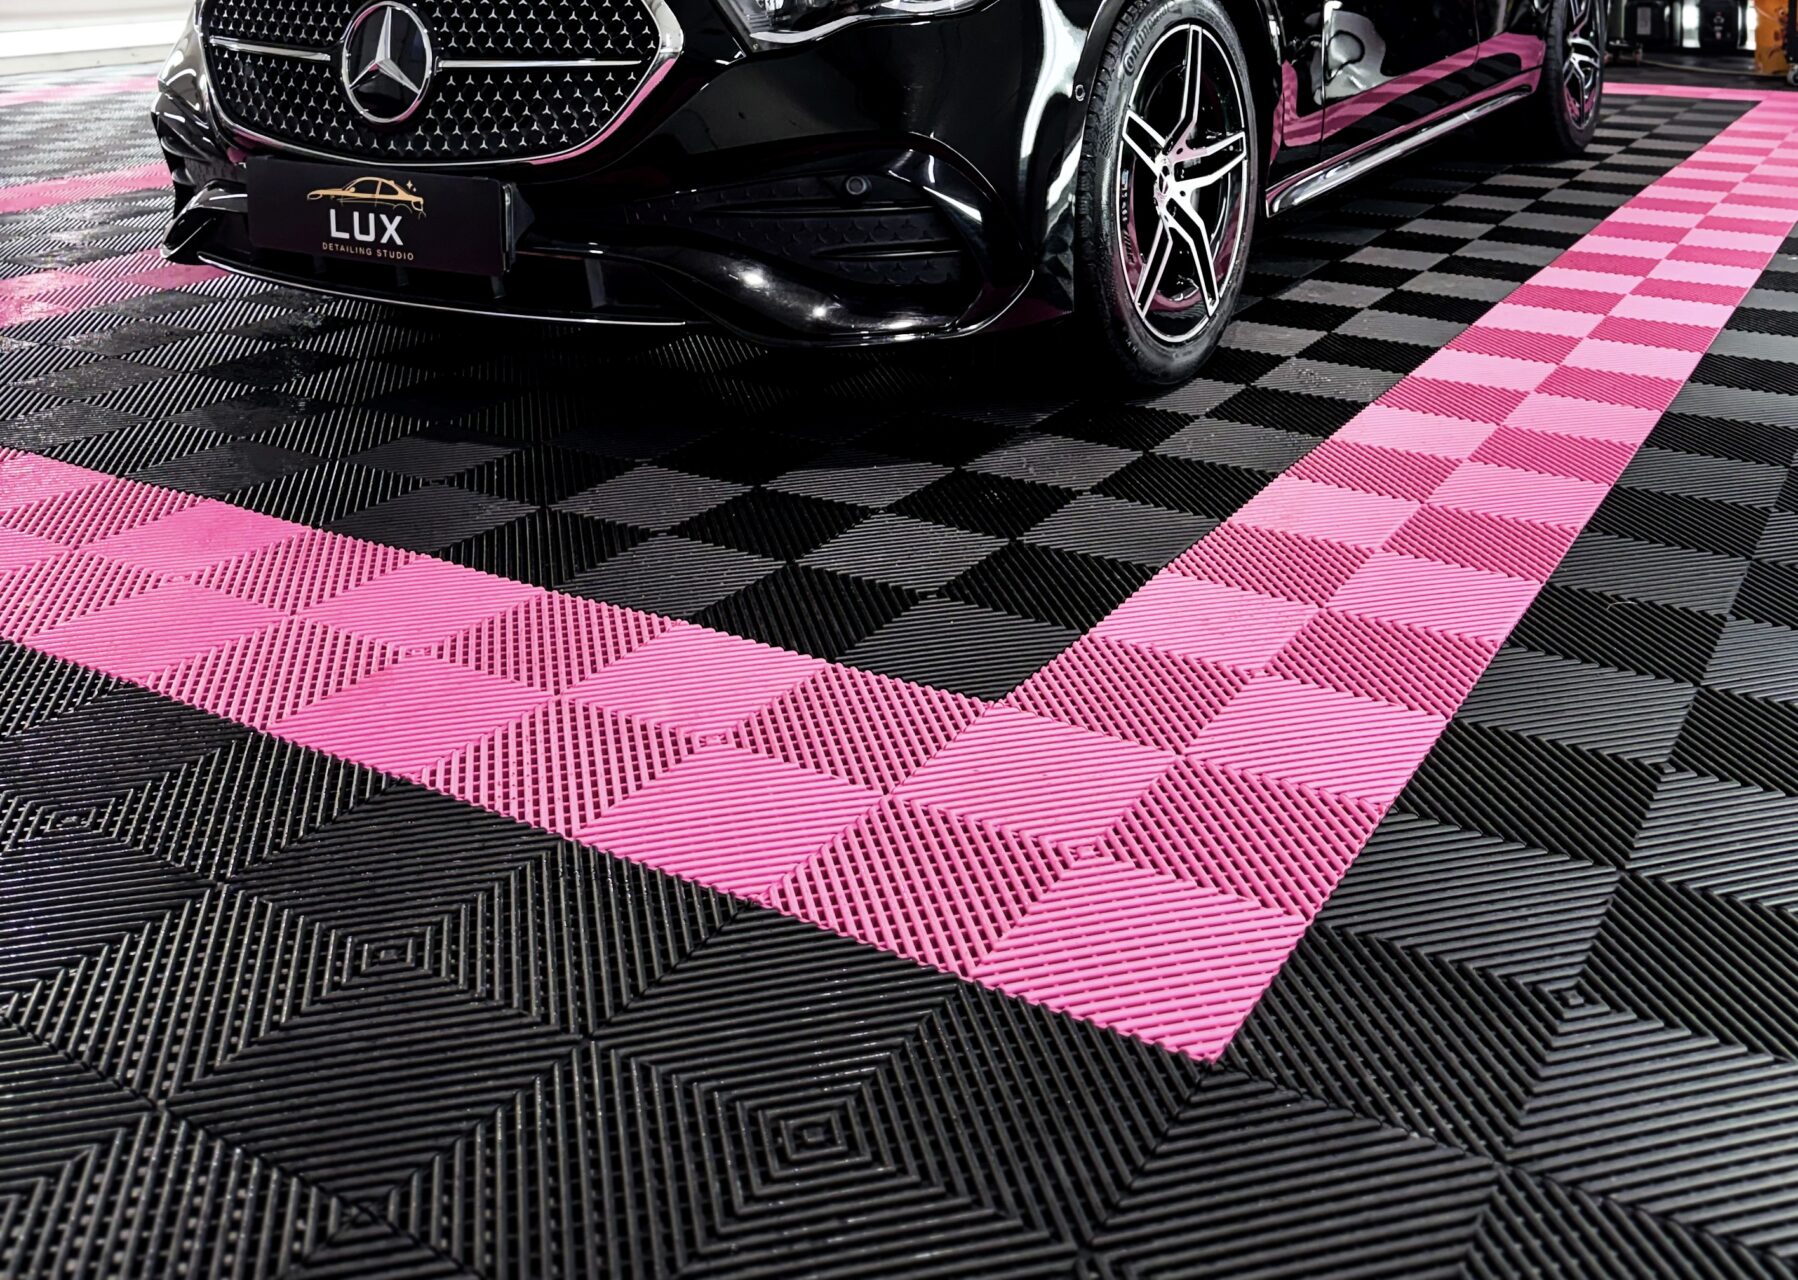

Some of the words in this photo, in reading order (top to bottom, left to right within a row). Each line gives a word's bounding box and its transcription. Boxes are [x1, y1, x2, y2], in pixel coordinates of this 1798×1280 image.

[329, 208, 404, 246] LUX
[322, 242, 373, 256] DETAILING
[376, 249, 414, 261] STUDIO
